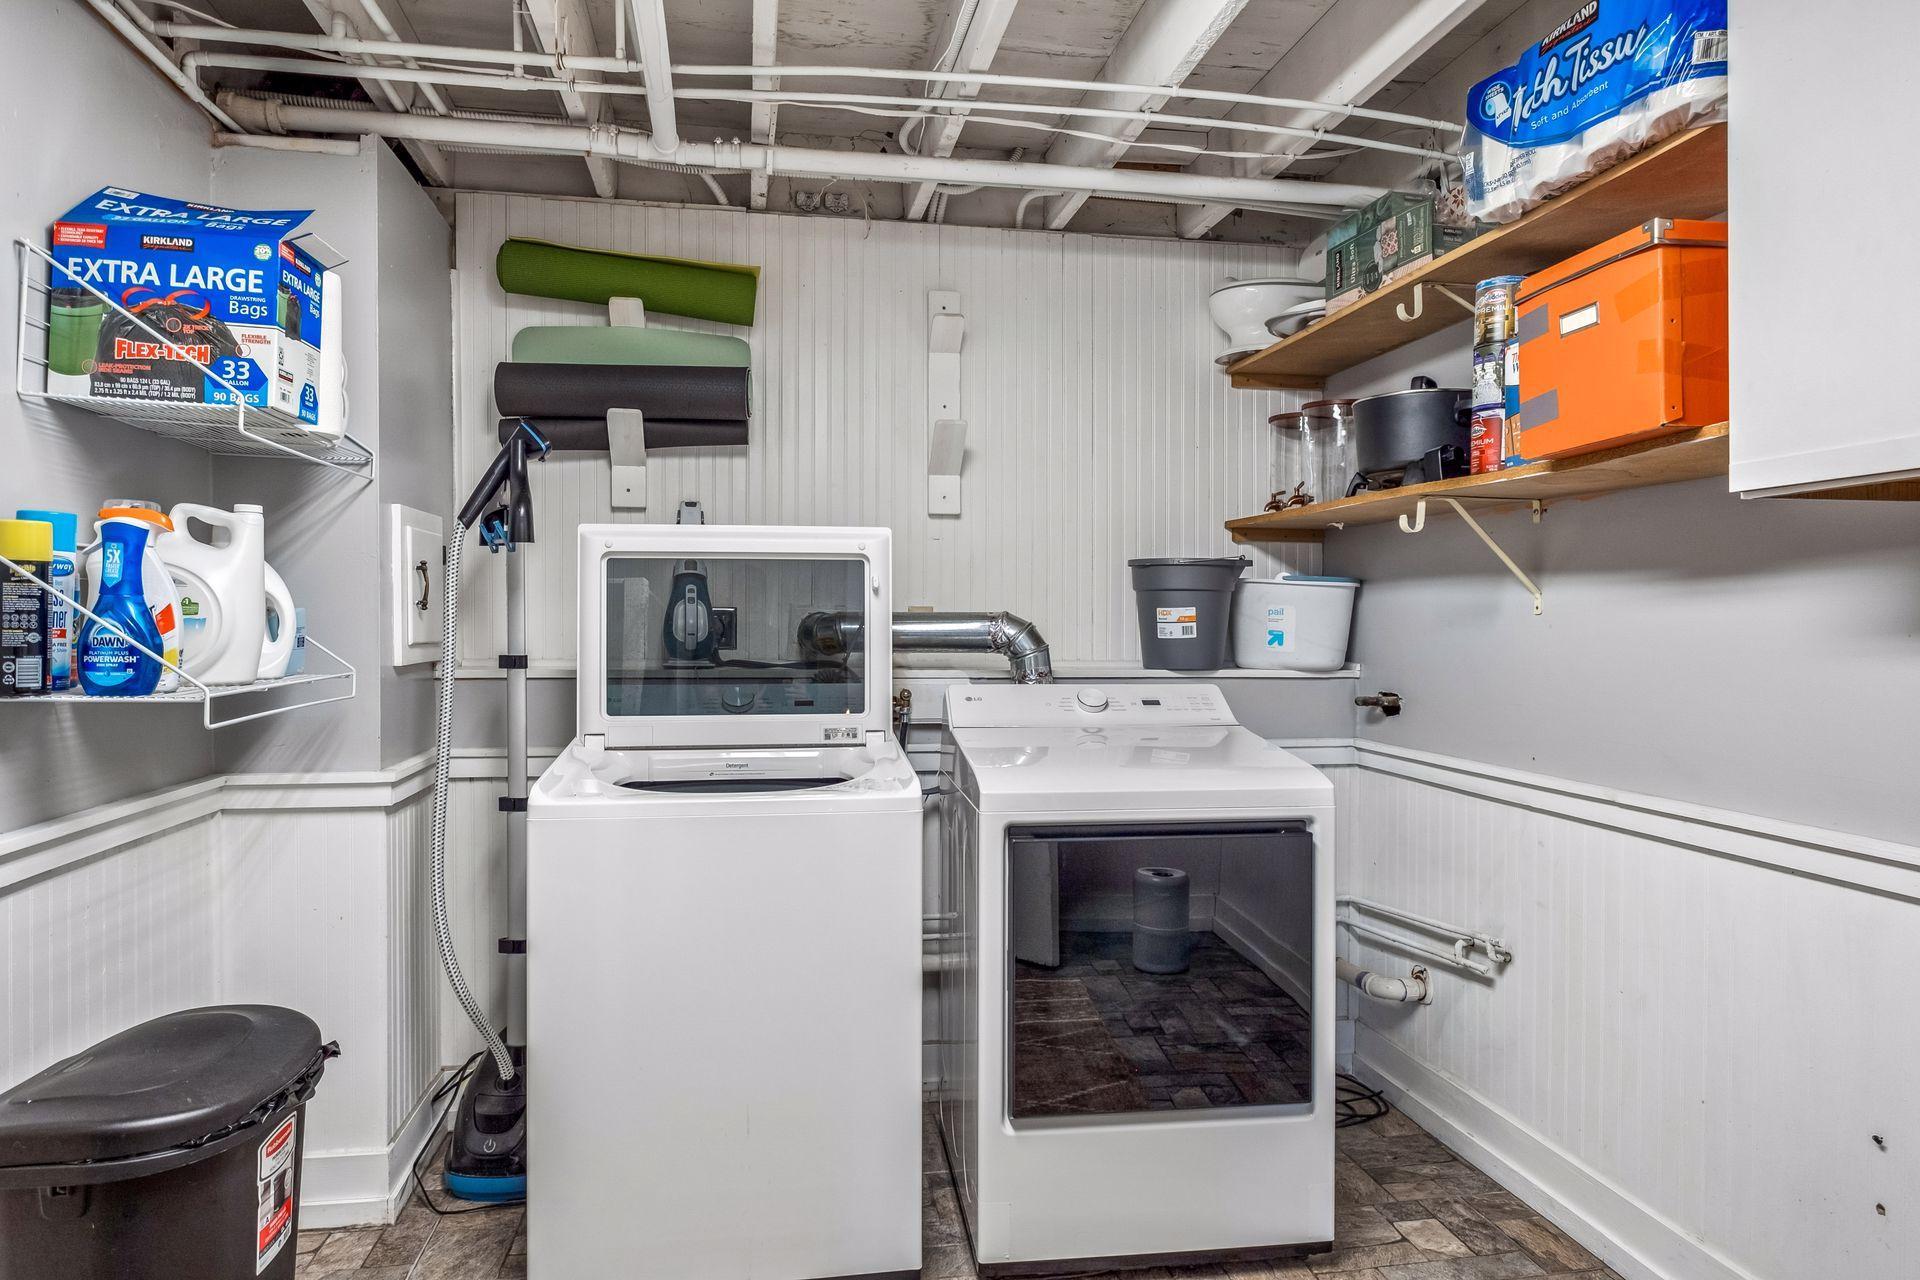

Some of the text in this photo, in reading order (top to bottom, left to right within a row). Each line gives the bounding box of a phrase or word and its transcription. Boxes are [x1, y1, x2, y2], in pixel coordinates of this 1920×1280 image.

[1531, 80, 1609, 130] Soft and Absorbent
[95, 199, 291, 226] EXTRA LARGE
[205, 222, 246, 231] Bags
[143, 235, 193, 247] KIRKLAND
[68, 257, 264, 293] EXTRA LARGE
[282, 270, 303, 292] EXTRA
[304, 283, 321, 304] LARGE
[230, 295, 266, 303] DRAWSTRING
[229, 300, 268, 319] Bags
[115, 337, 211, 365] FLEX-TECH
[222, 360, 250, 380] 33
[213, 392, 227, 402] 90
[305, 385, 314, 402] 33
[106, 549, 121, 564] 5X
[1268, 607, 1284, 617] pail
[92, 636, 126, 648] DAWN
